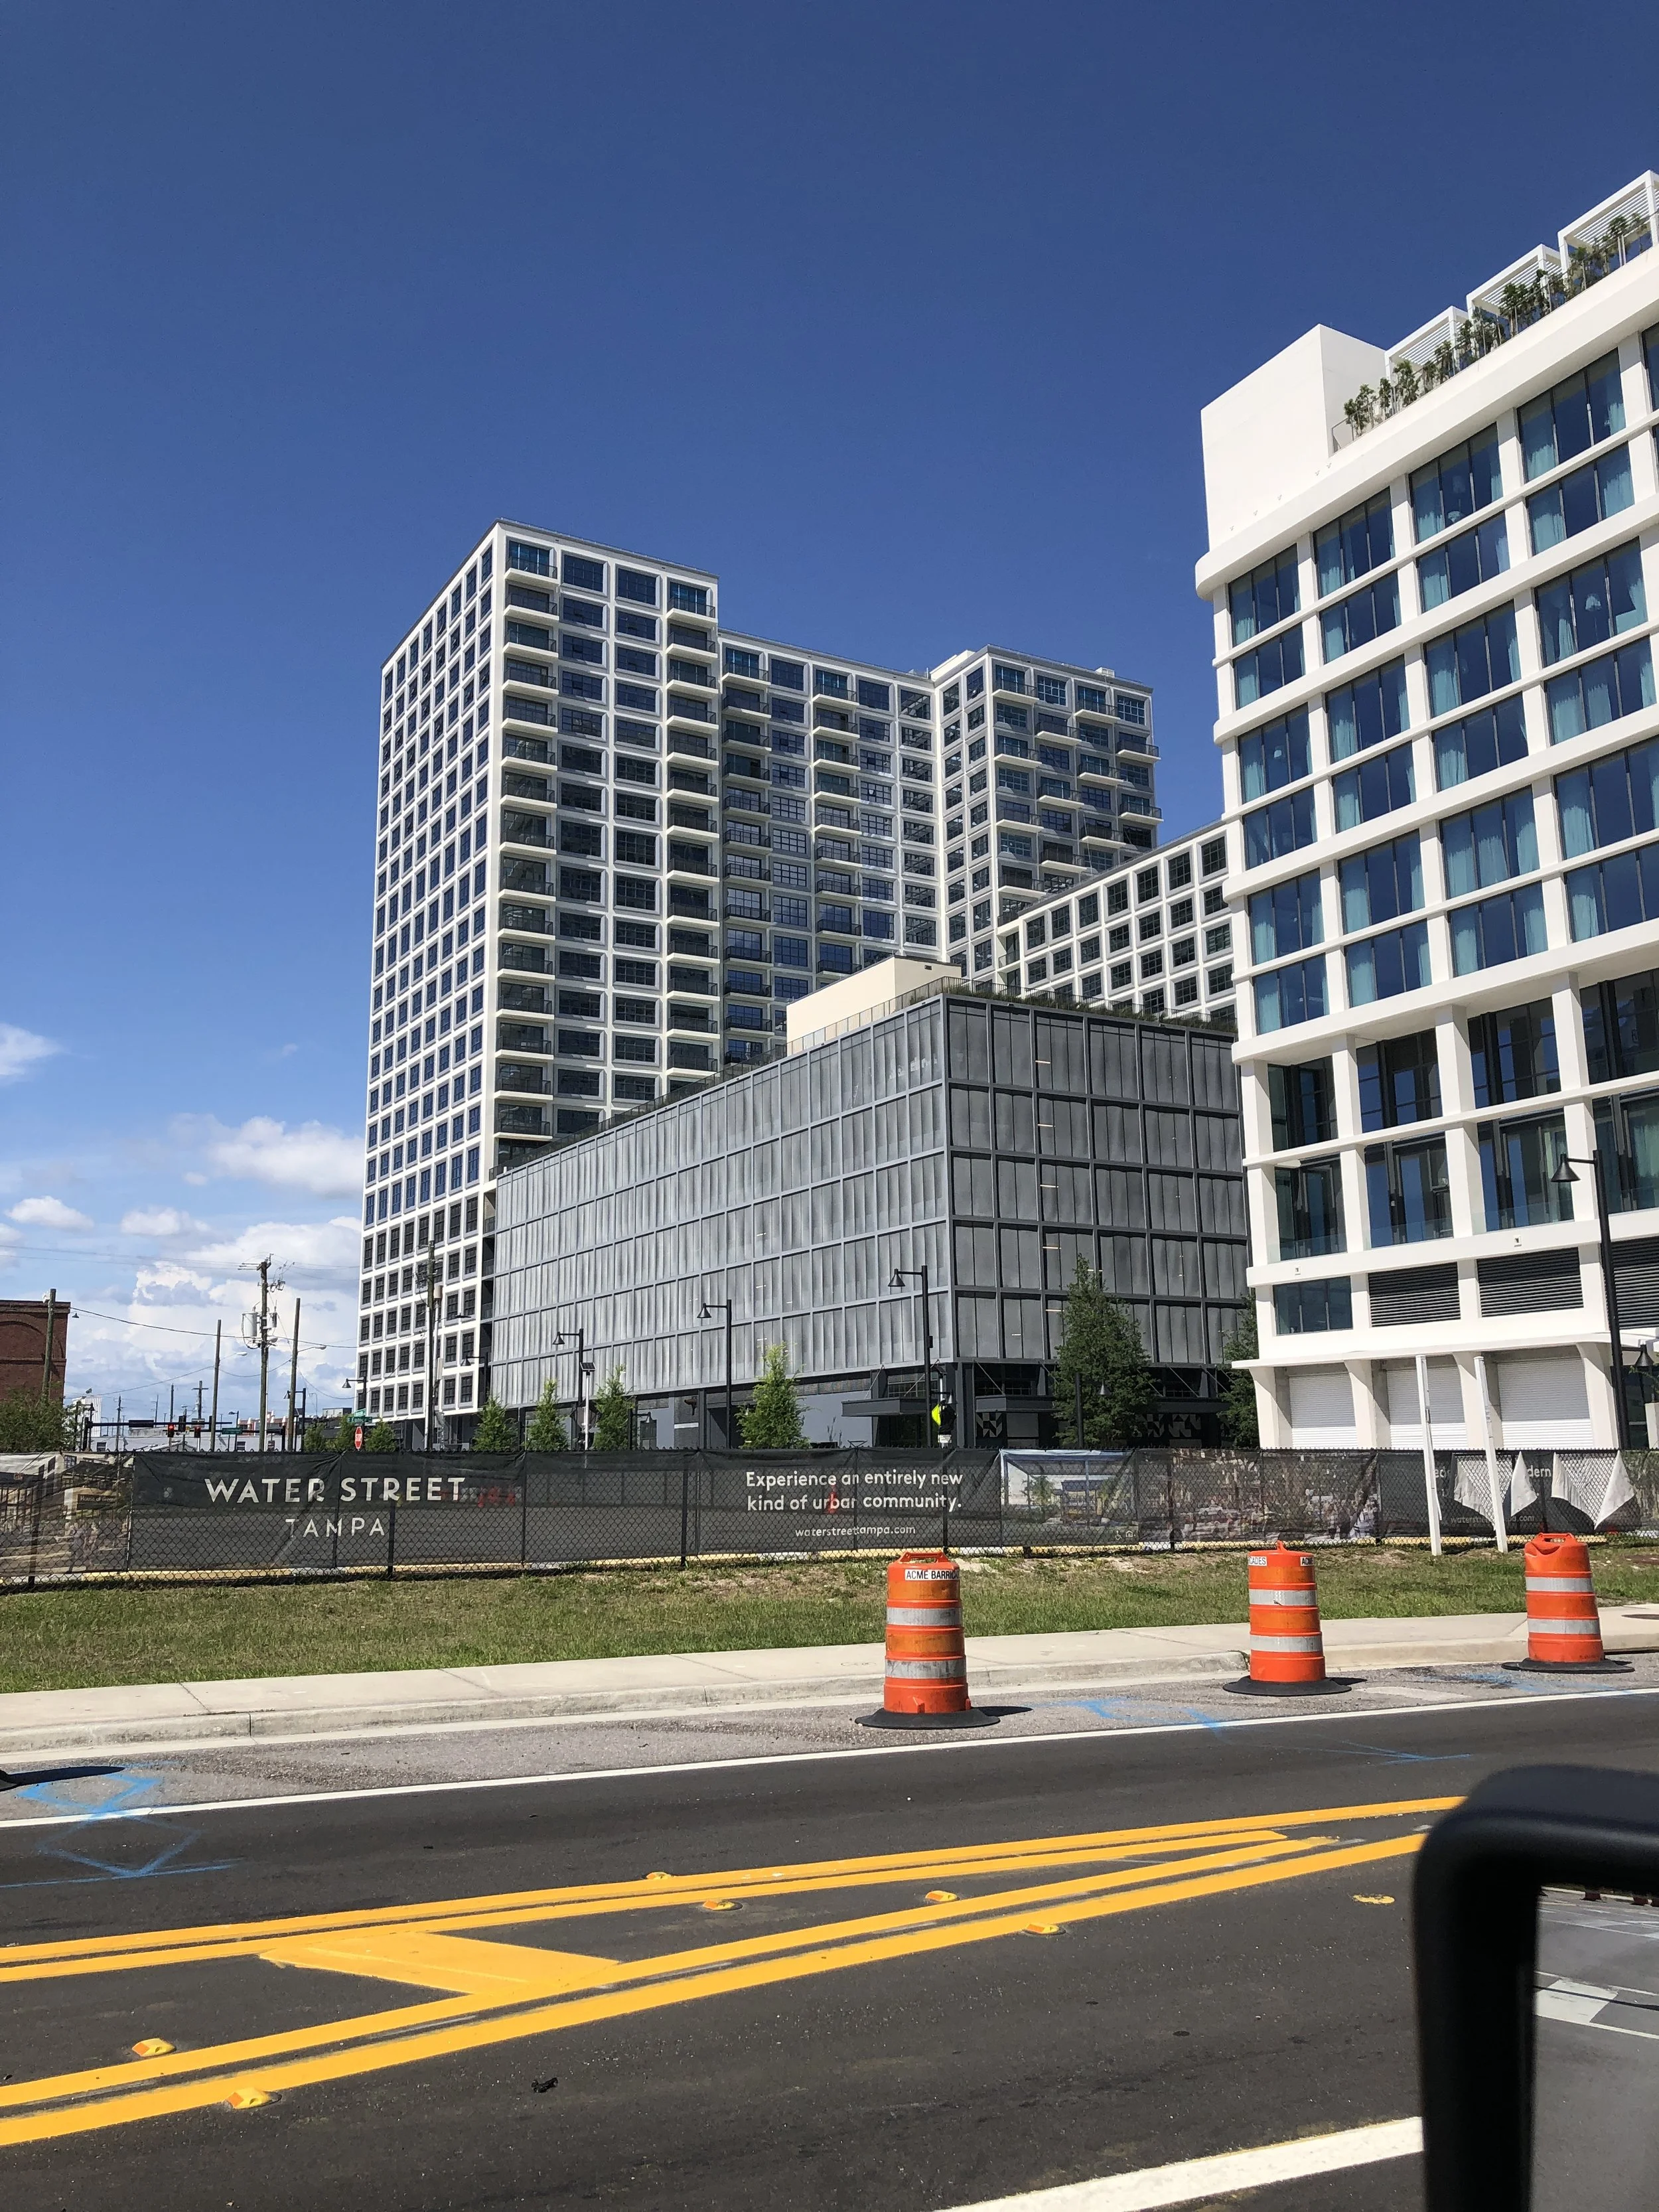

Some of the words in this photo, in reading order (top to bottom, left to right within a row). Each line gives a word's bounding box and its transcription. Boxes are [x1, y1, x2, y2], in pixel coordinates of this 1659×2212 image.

[745, 1471, 837, 1491] Experience
[841, 1473, 859, 1485] an
[864, 1469, 926, 1489] entirely
[931, 1472, 964, 1485] new
[204, 1477, 325, 1504] WATER
[340, 1477, 466, 1502] STREET
[747, 1495, 784, 1511] kind
[790, 1494, 808, 1510] of
[863, 1492, 962, 1512] community.
[285, 1517, 385, 1538] TAMPA
[795, 1525, 916, 1538] waterstreettampa.com
[906, 1570, 929, 1580] ACME
